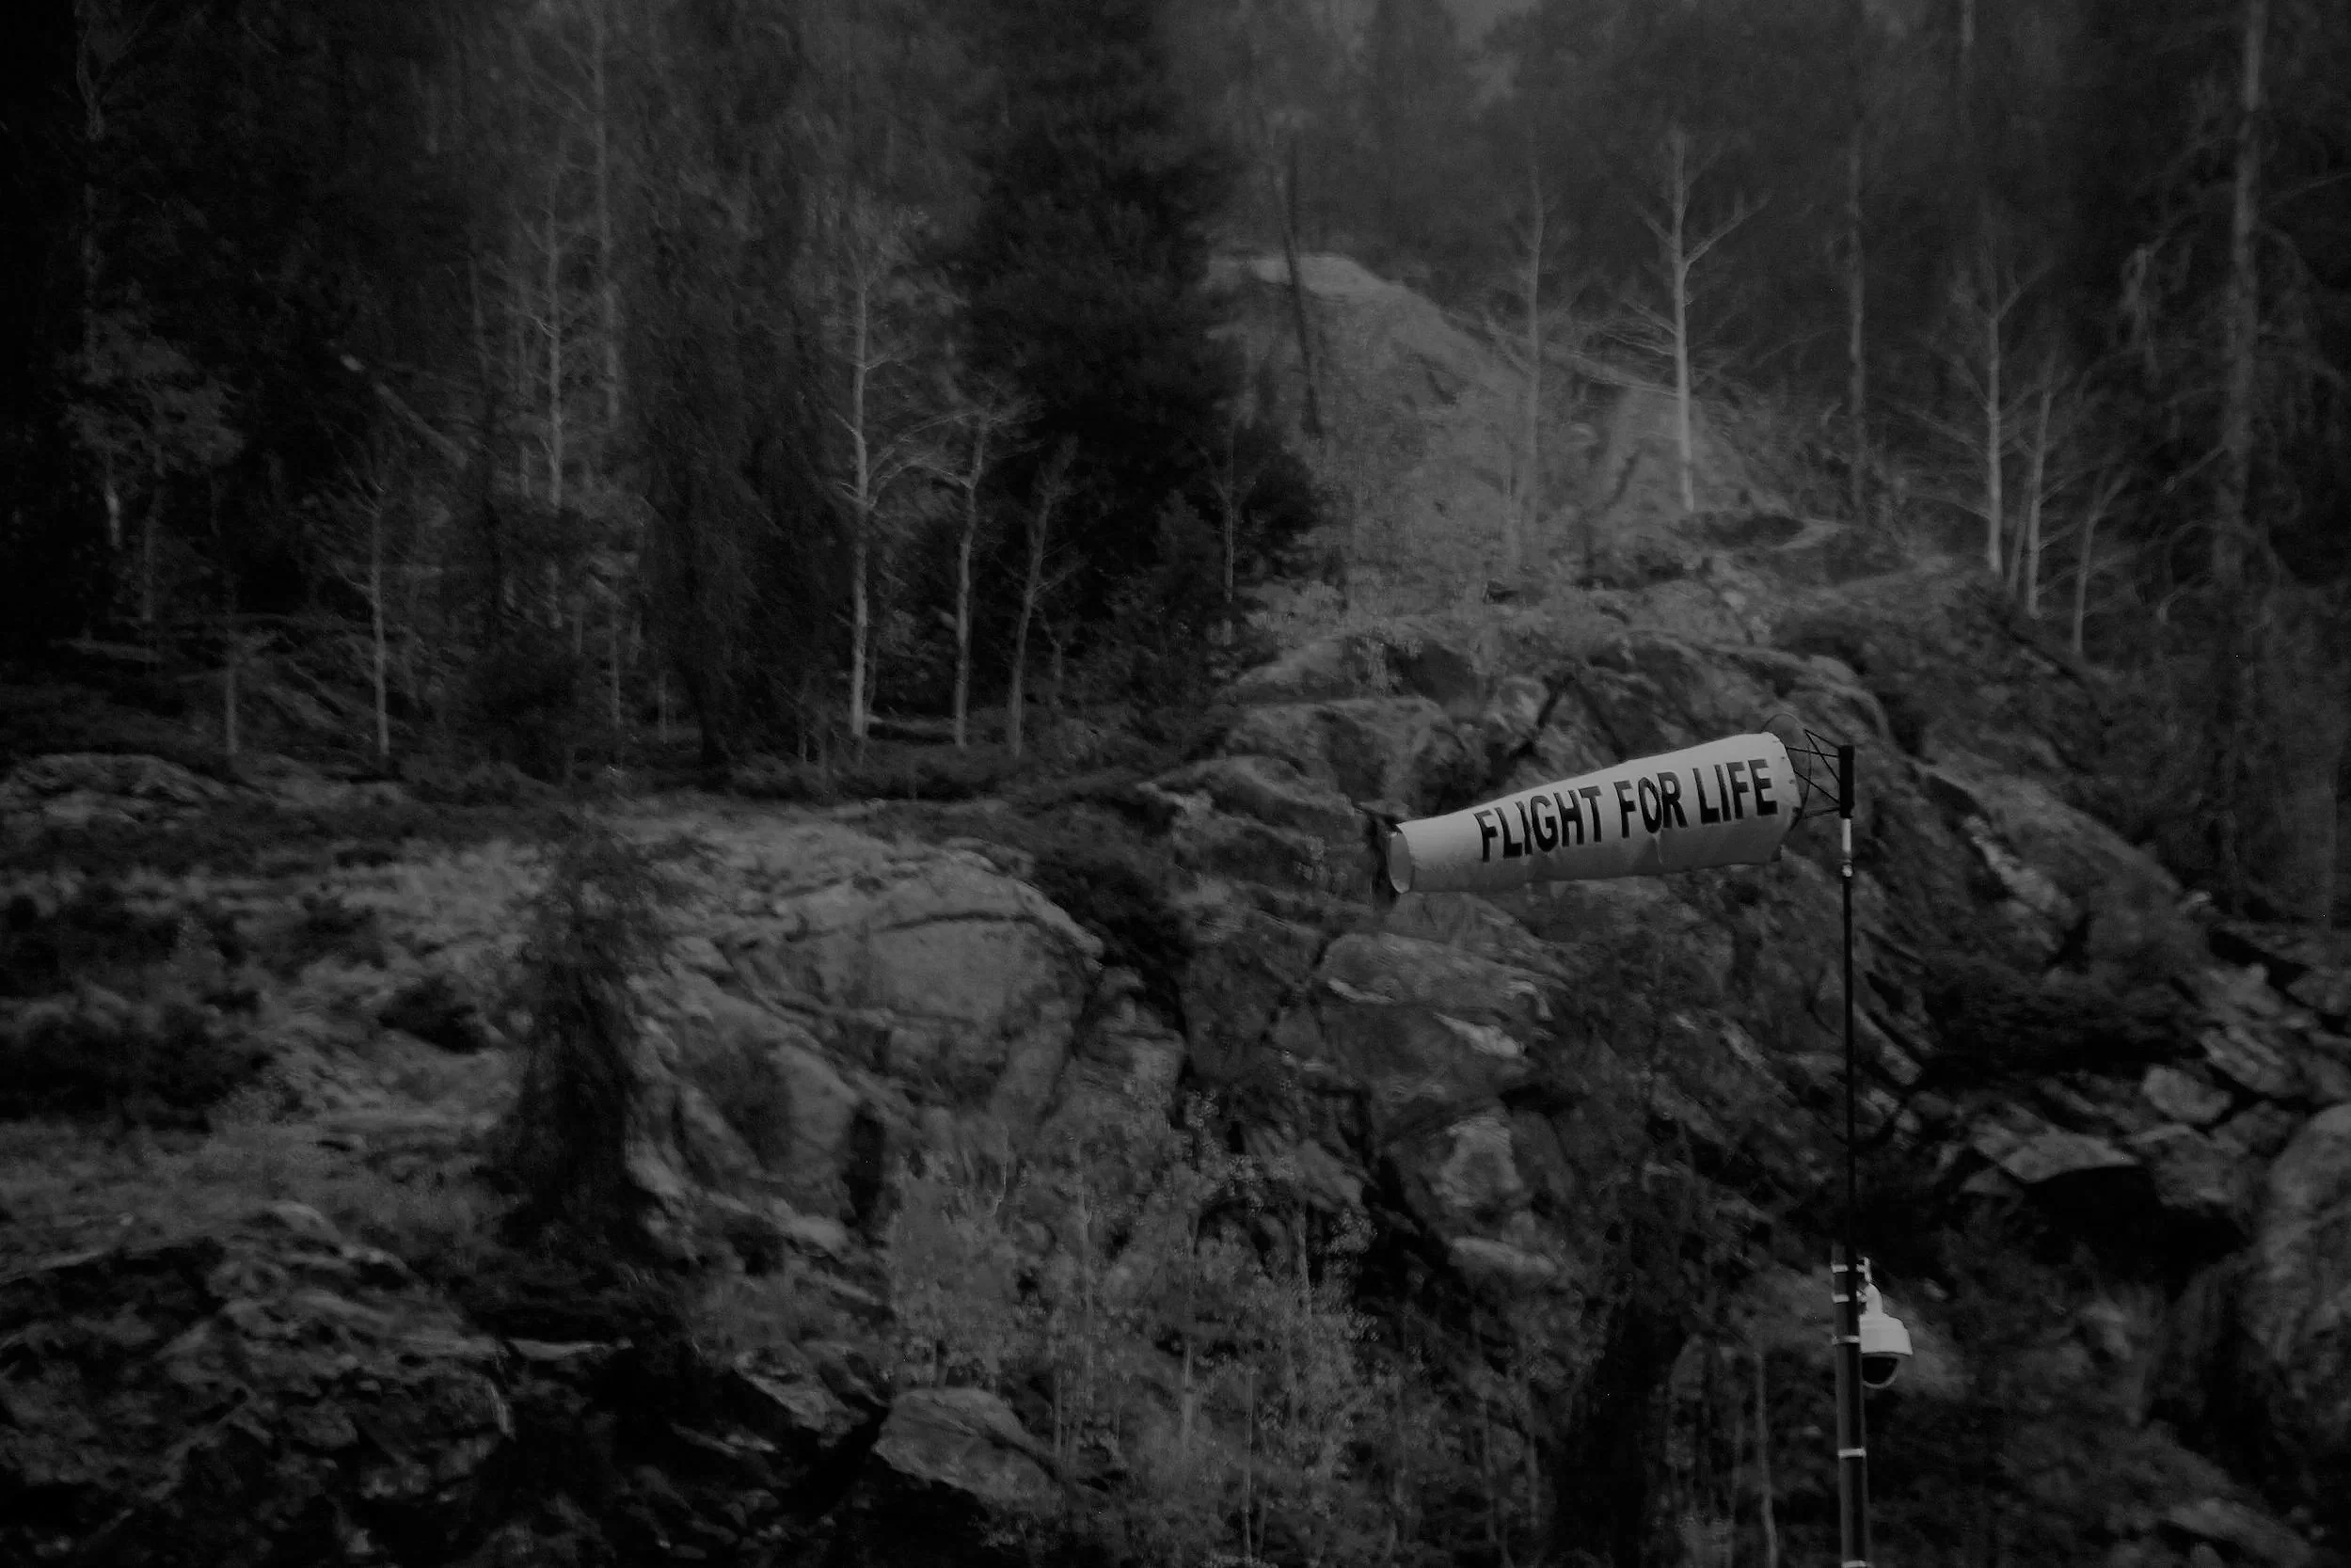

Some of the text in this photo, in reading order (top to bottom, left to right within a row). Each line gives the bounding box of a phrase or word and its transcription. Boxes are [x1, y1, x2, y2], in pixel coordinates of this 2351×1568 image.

[1473, 759, 1778, 863] FLIGHT FOR LIFE
